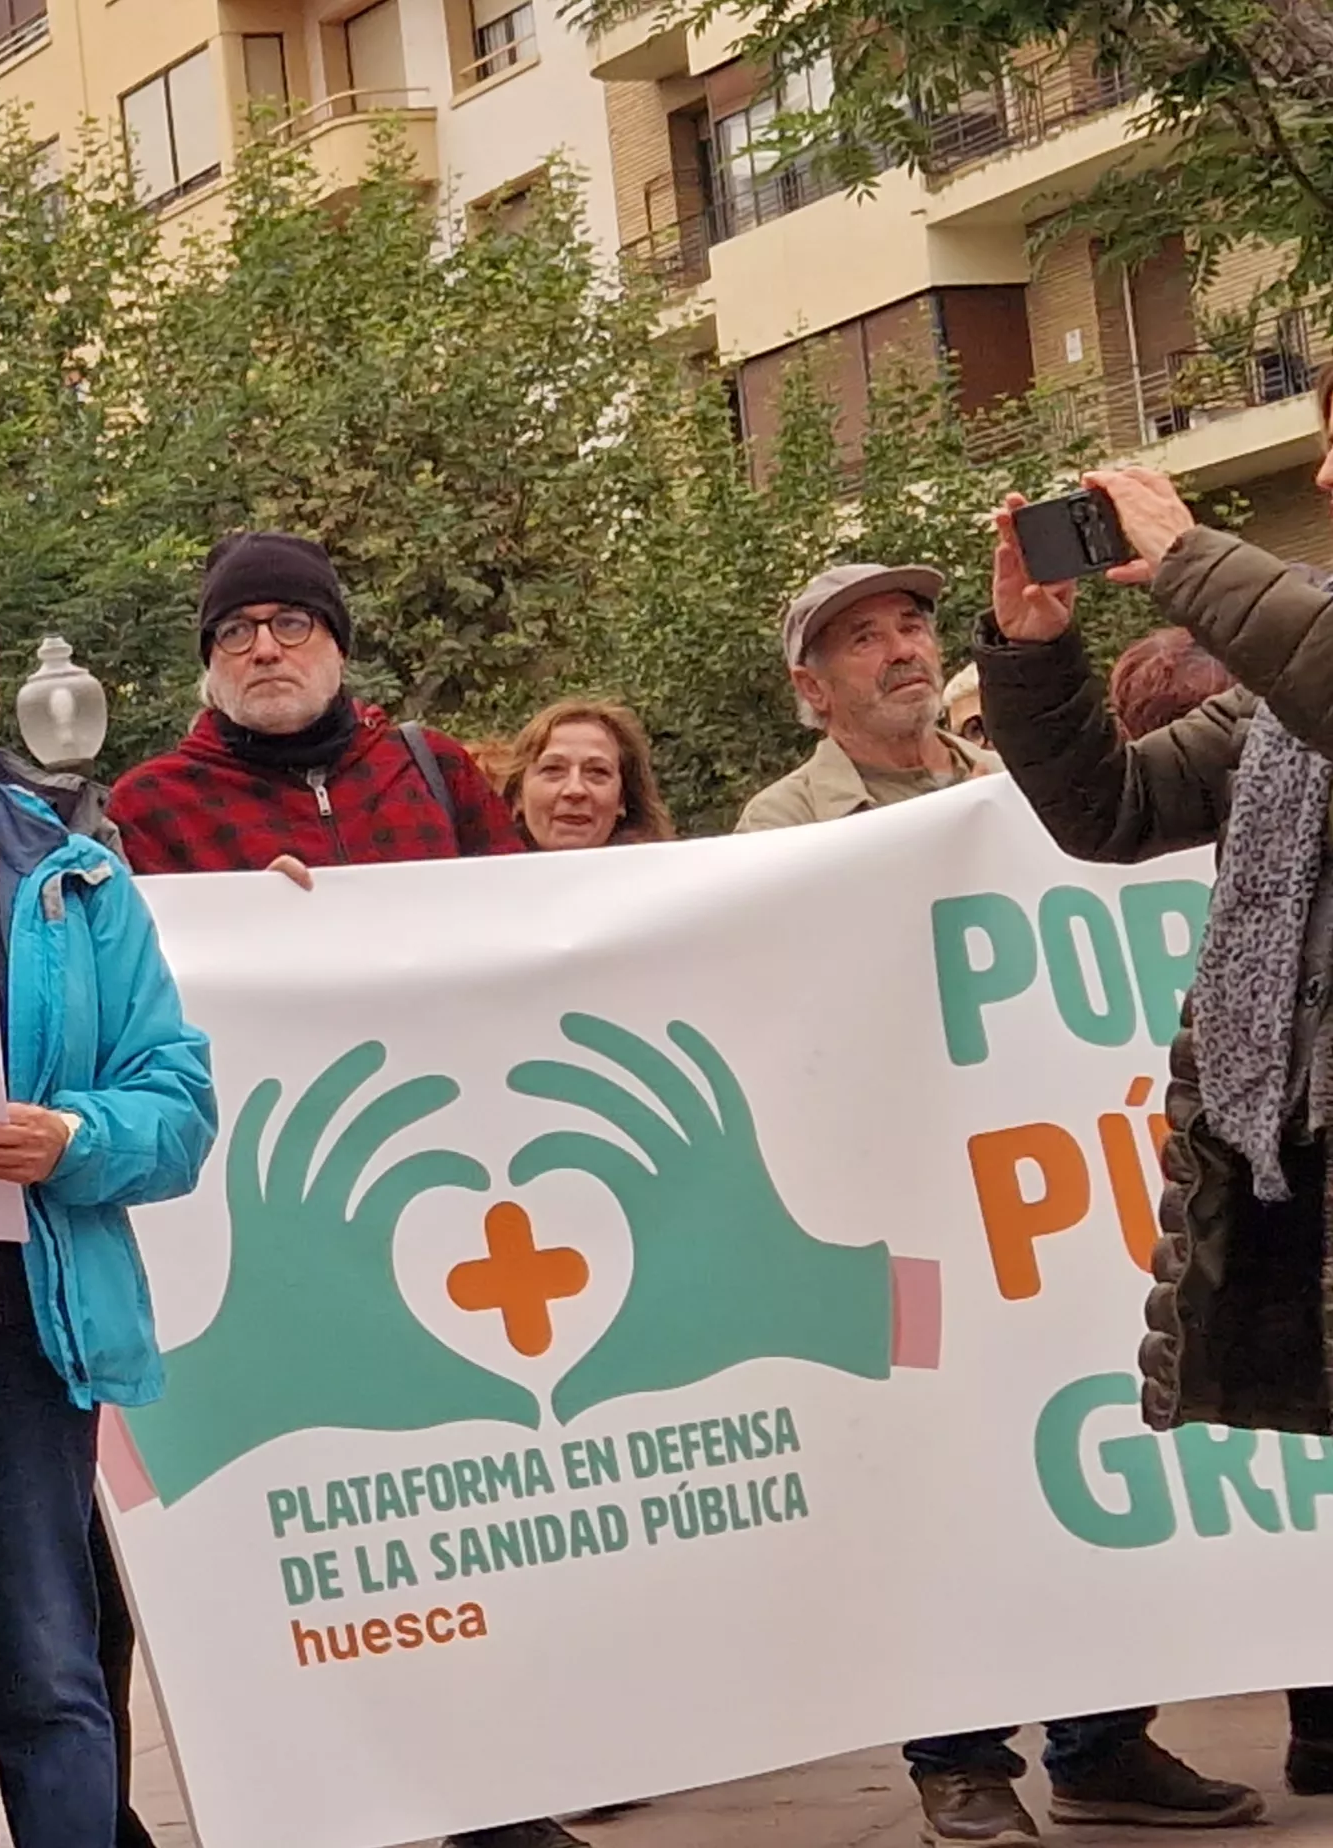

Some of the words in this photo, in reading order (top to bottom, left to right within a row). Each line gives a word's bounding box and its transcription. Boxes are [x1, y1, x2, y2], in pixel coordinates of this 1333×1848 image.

[267, 1448, 554, 1538] PLATAFORMA
[561, 1437, 619, 1489] EN
[625, 1407, 800, 1479] DEFENSA
[280, 1551, 344, 1606] DE
[356, 1539, 418, 1594] LA
[431, 1504, 630, 1582] SANIDAD
[641, 1472, 810, 1546] PÚBLICA
[290, 1602, 489, 1667] huesca
